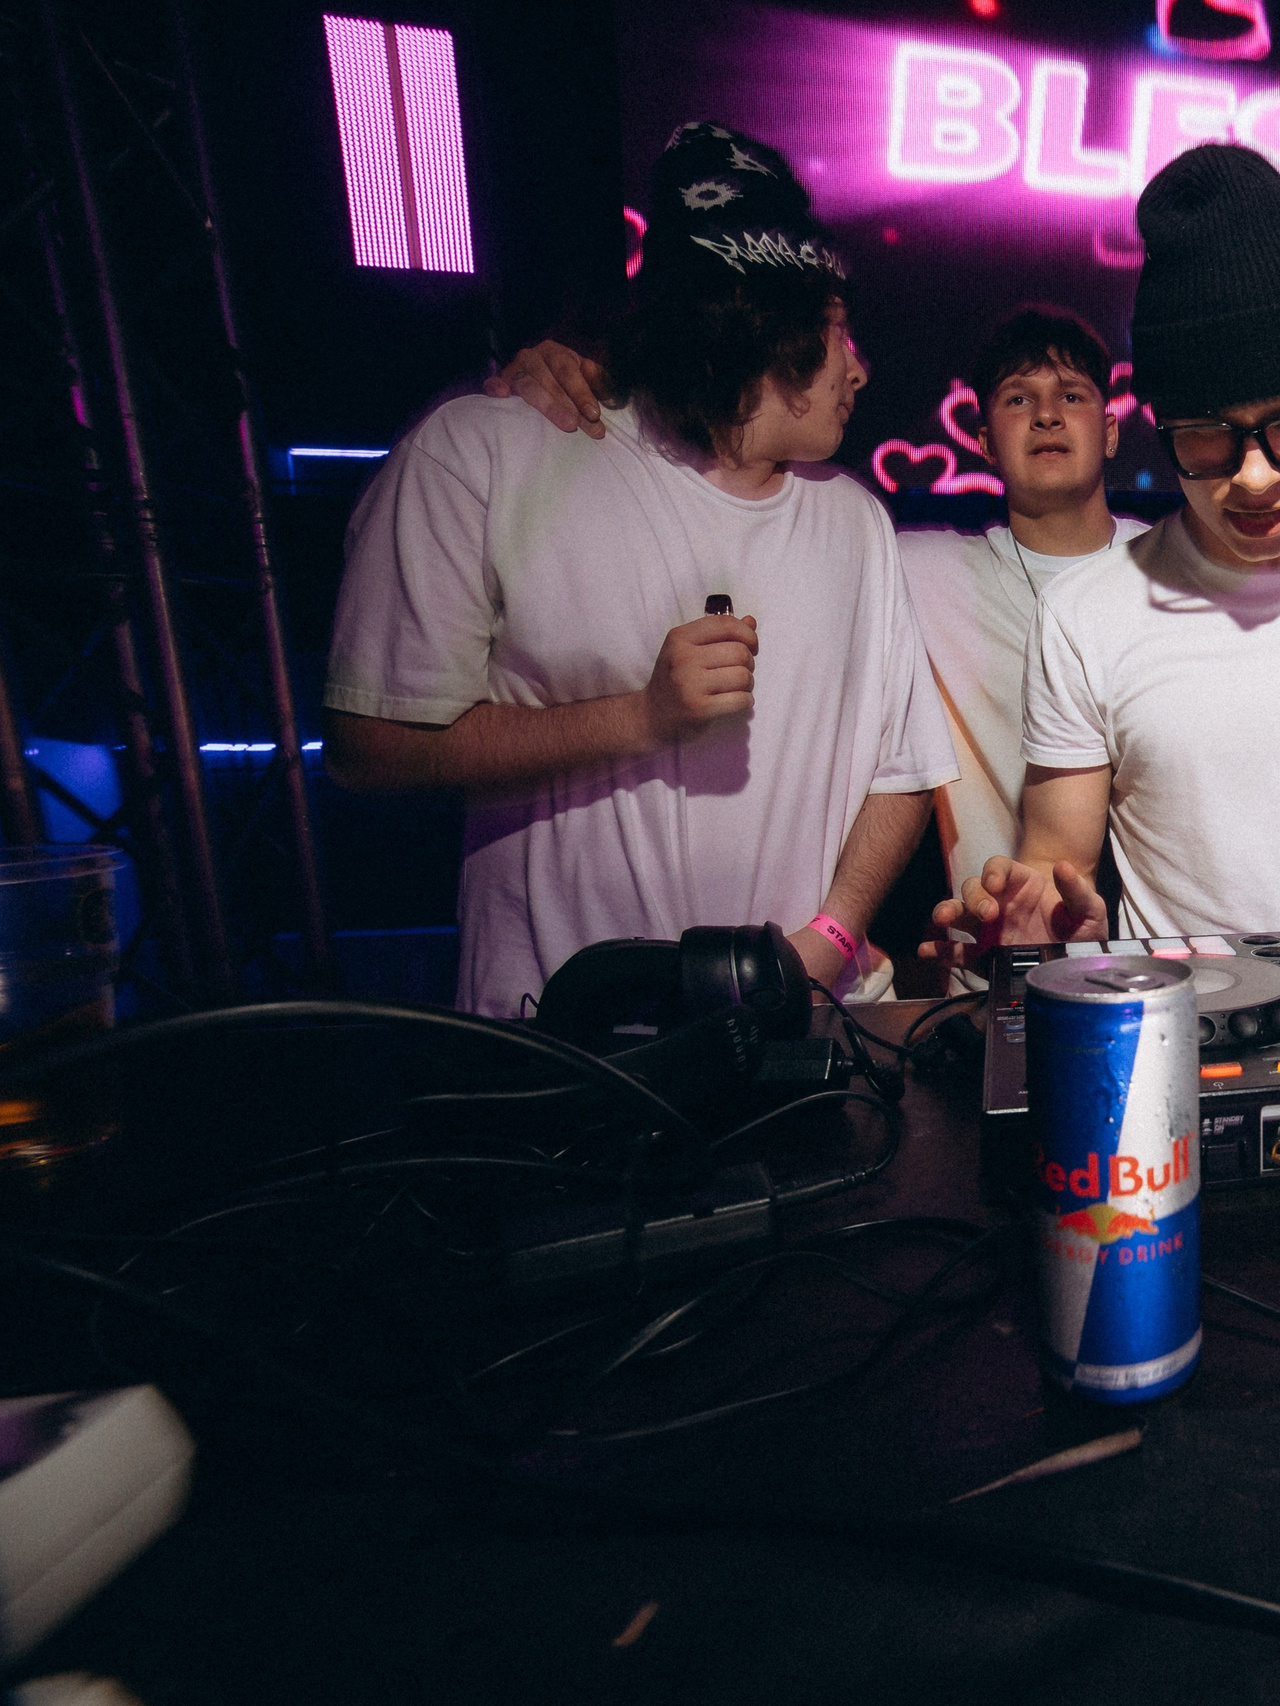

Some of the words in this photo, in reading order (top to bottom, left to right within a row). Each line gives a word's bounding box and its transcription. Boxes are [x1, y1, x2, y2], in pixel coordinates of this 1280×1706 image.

[827, 925, 854, 953] STAFF
[1213, 1115, 1244, 1124] STANDBY
[1108, 1135, 1190, 1198] Bull
[1043, 1234, 1110, 1266] NERGY
[1117, 1230, 1185, 1267] DRINK
